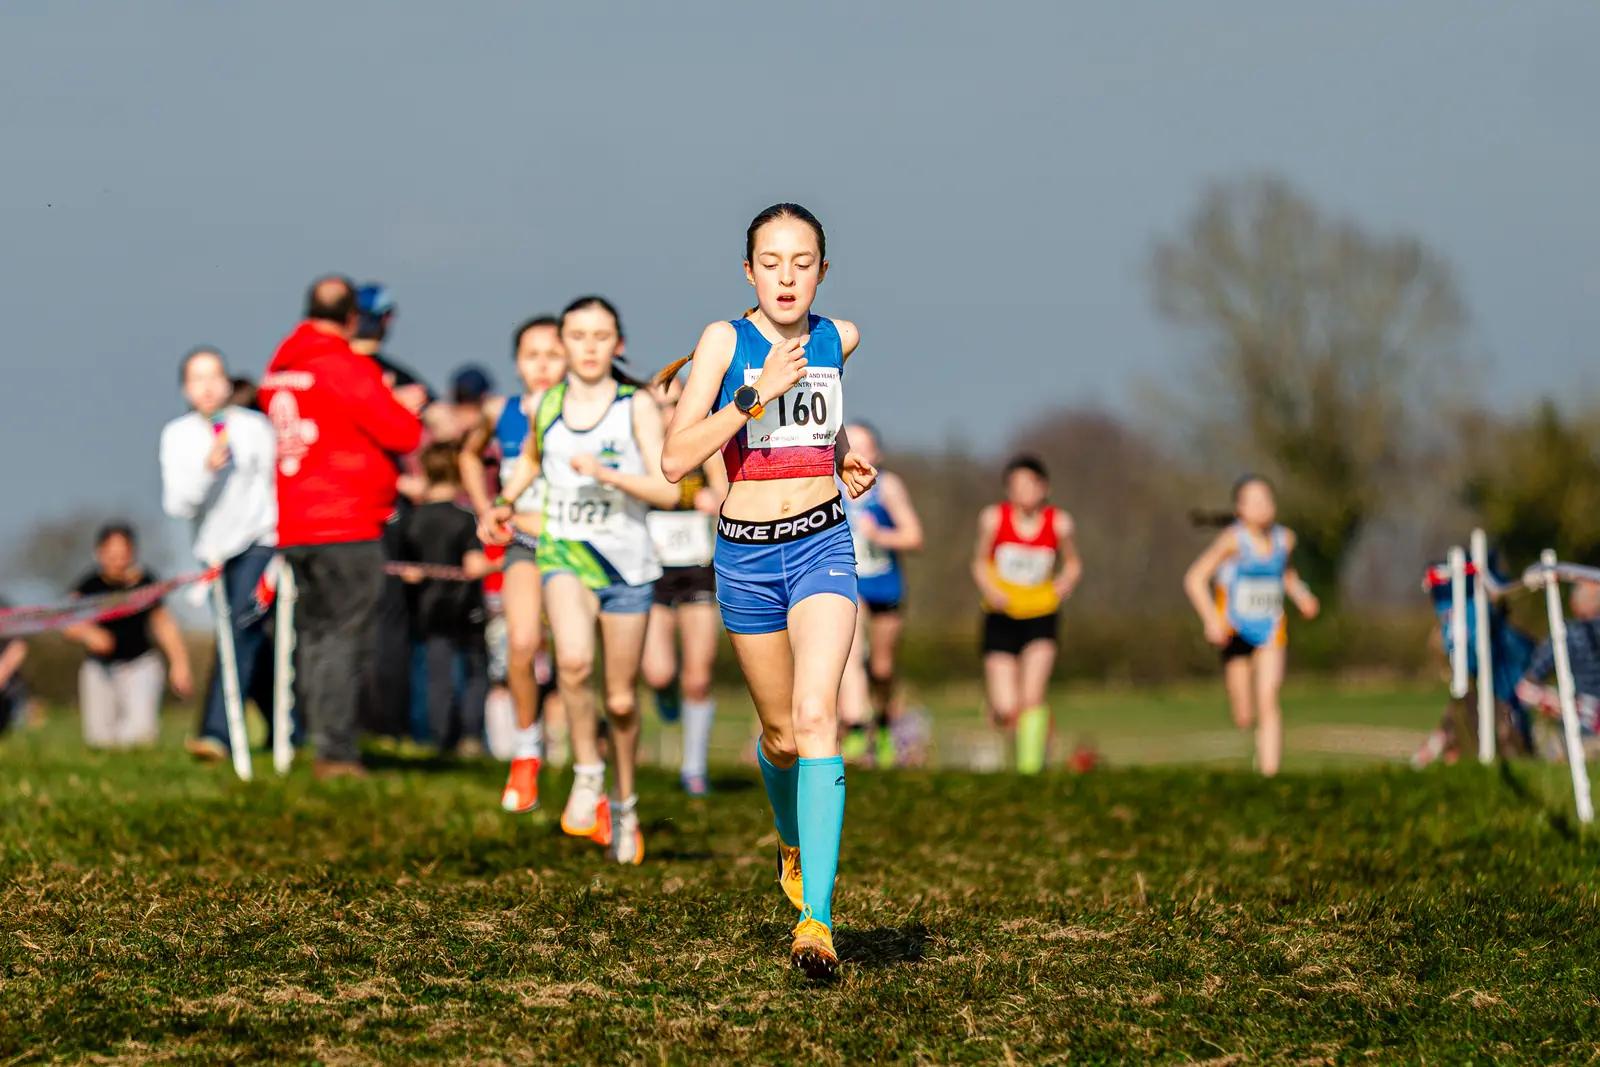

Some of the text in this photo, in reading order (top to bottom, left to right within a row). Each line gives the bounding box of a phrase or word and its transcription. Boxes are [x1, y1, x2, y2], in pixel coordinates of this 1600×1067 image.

[778, 391, 827, 426] 160
[558, 499, 611, 525] 1027
[718, 517, 771, 540] NIKE
[773, 510, 827, 539] PRO
